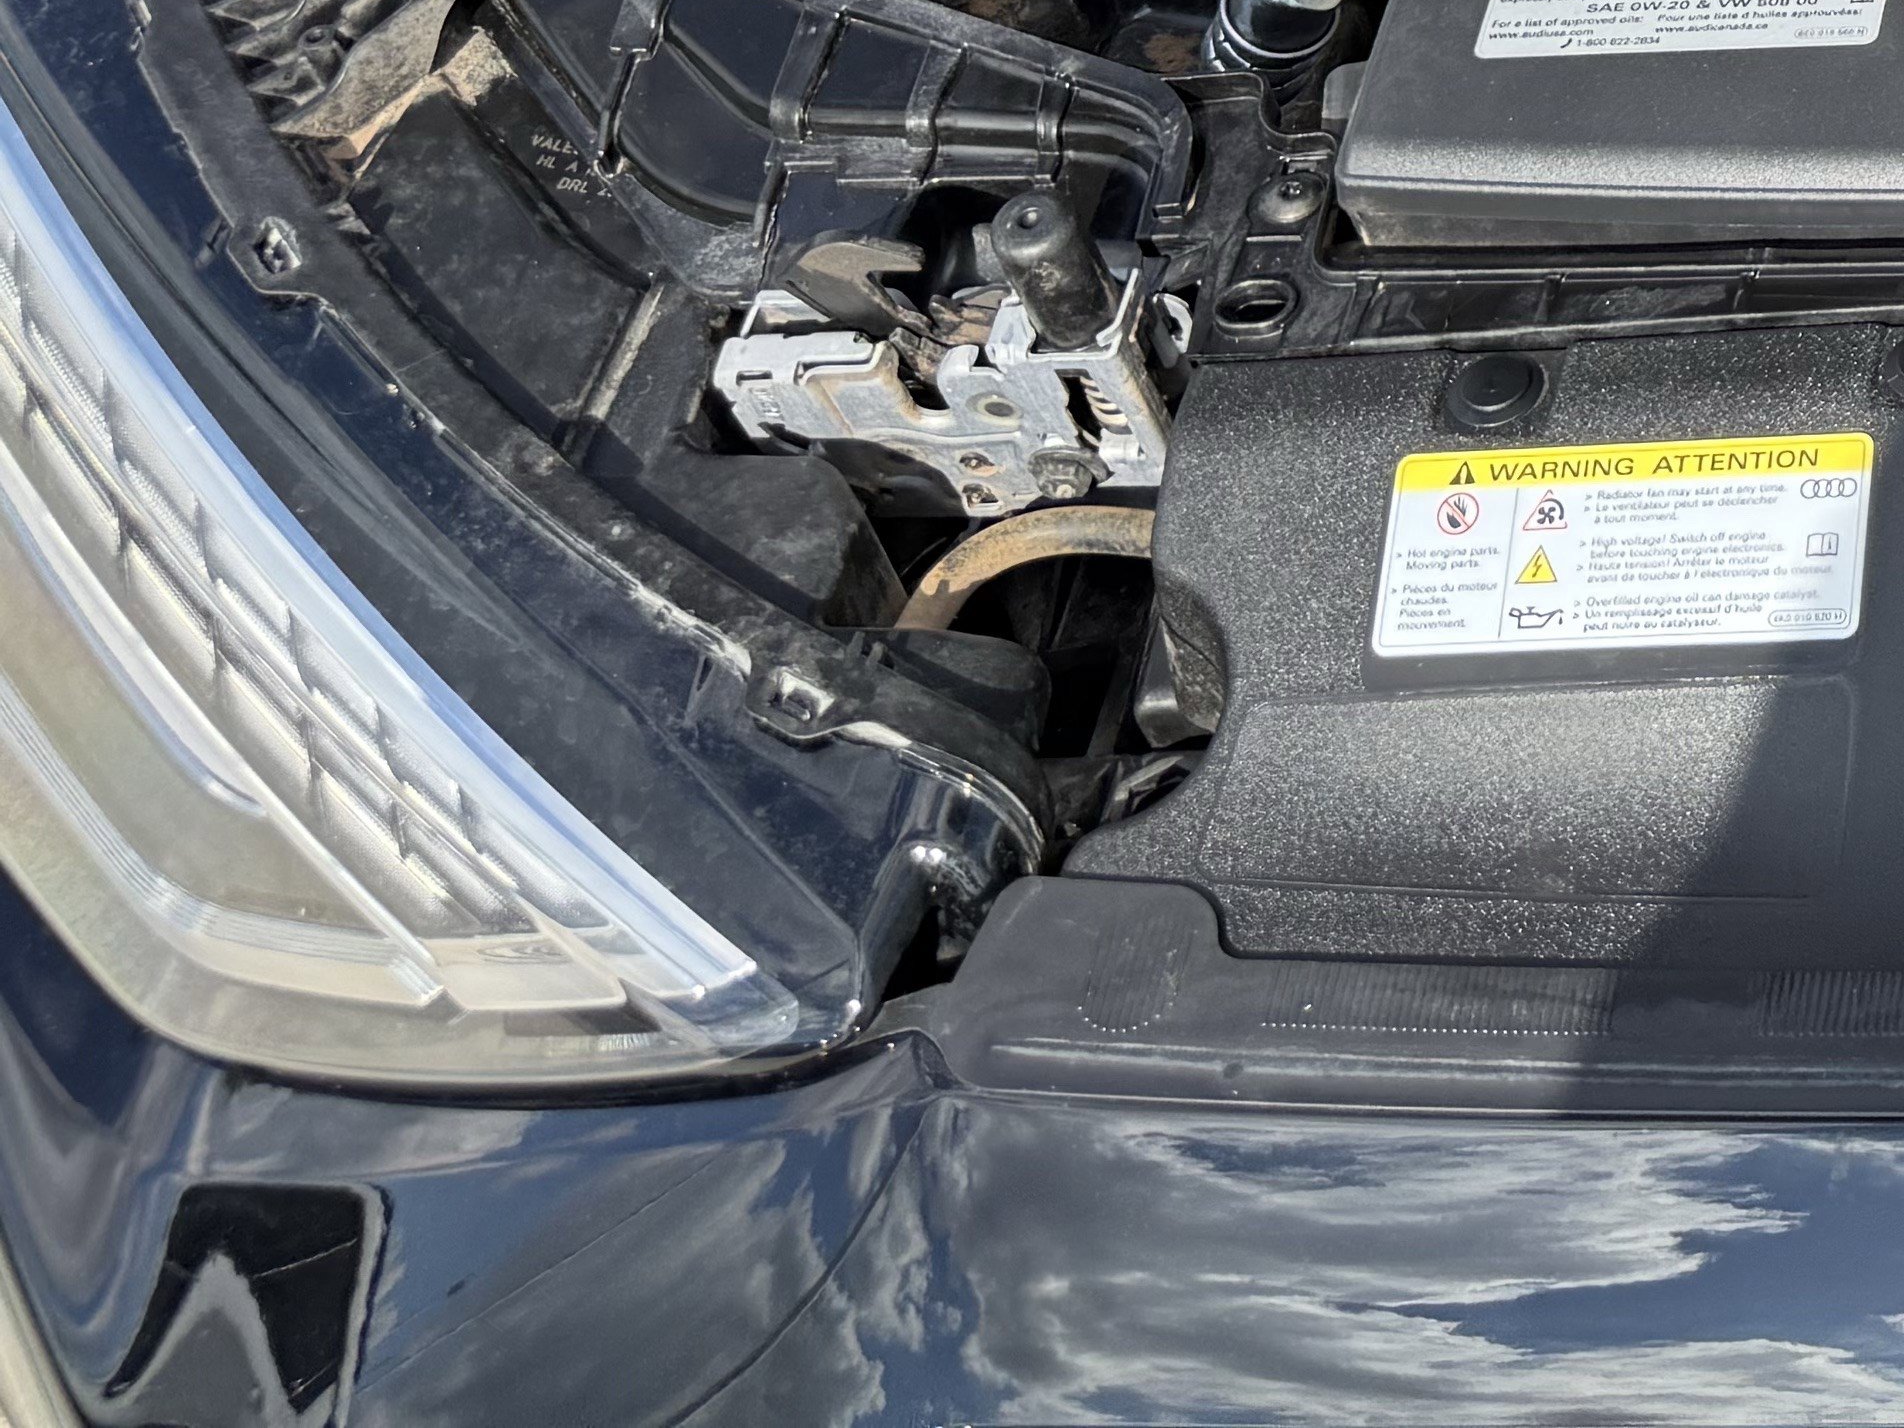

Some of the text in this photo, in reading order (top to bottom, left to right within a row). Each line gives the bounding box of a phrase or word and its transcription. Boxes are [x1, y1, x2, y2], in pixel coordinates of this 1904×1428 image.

[1587, 2, 1625, 13] SAE
[1696, 0, 1711, 9] &
[1525, 18, 1542, 26] list
[1546, 18, 1558, 26] of
[1561, 16, 1616, 27] approved
[1489, 28, 1594, 39] www.audiusa.com
[1489, 447, 1820, 482] WARNING ATTENTION
[1597, 490, 1643, 501] Radiator
[1667, 488, 1691, 498] may
[1695, 486, 1720, 496] start
[1408, 549, 1426, 558] Hot
[1430, 548, 1467, 558] engine
[1406, 561, 1447, 570] Moving
[1441, 584, 1454, 592] du
